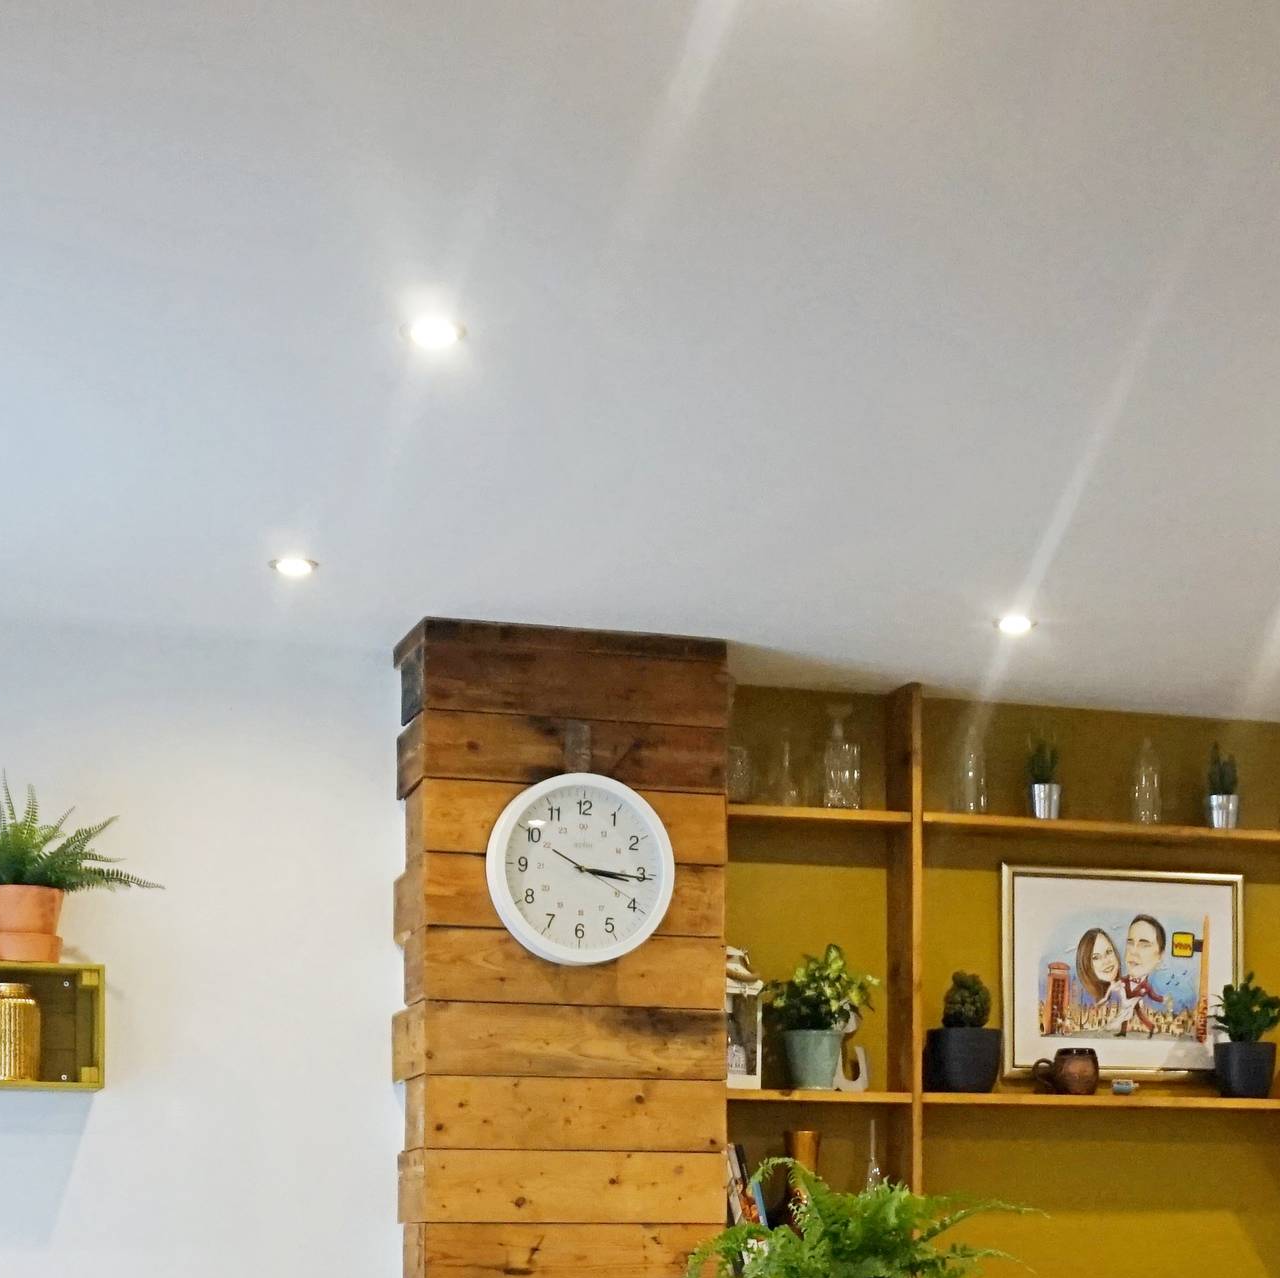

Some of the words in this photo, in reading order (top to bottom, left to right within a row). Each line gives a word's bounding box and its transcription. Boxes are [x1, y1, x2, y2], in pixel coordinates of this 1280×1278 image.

[547, 807, 561, 822] 11
[577, 800, 593, 816] 12
[610, 812, 617, 827] 1
[527, 827, 541, 843] 10
[628, 835, 639, 851] 2
[518, 856, 528, 872] 9
[636, 866, 646, 882] 3
[524, 888, 535, 904] 8
[627, 897, 637, 912] 4
[545, 913, 556, 929] 7
[604, 917, 615, 933] 5
[574, 923, 585, 939] 6
